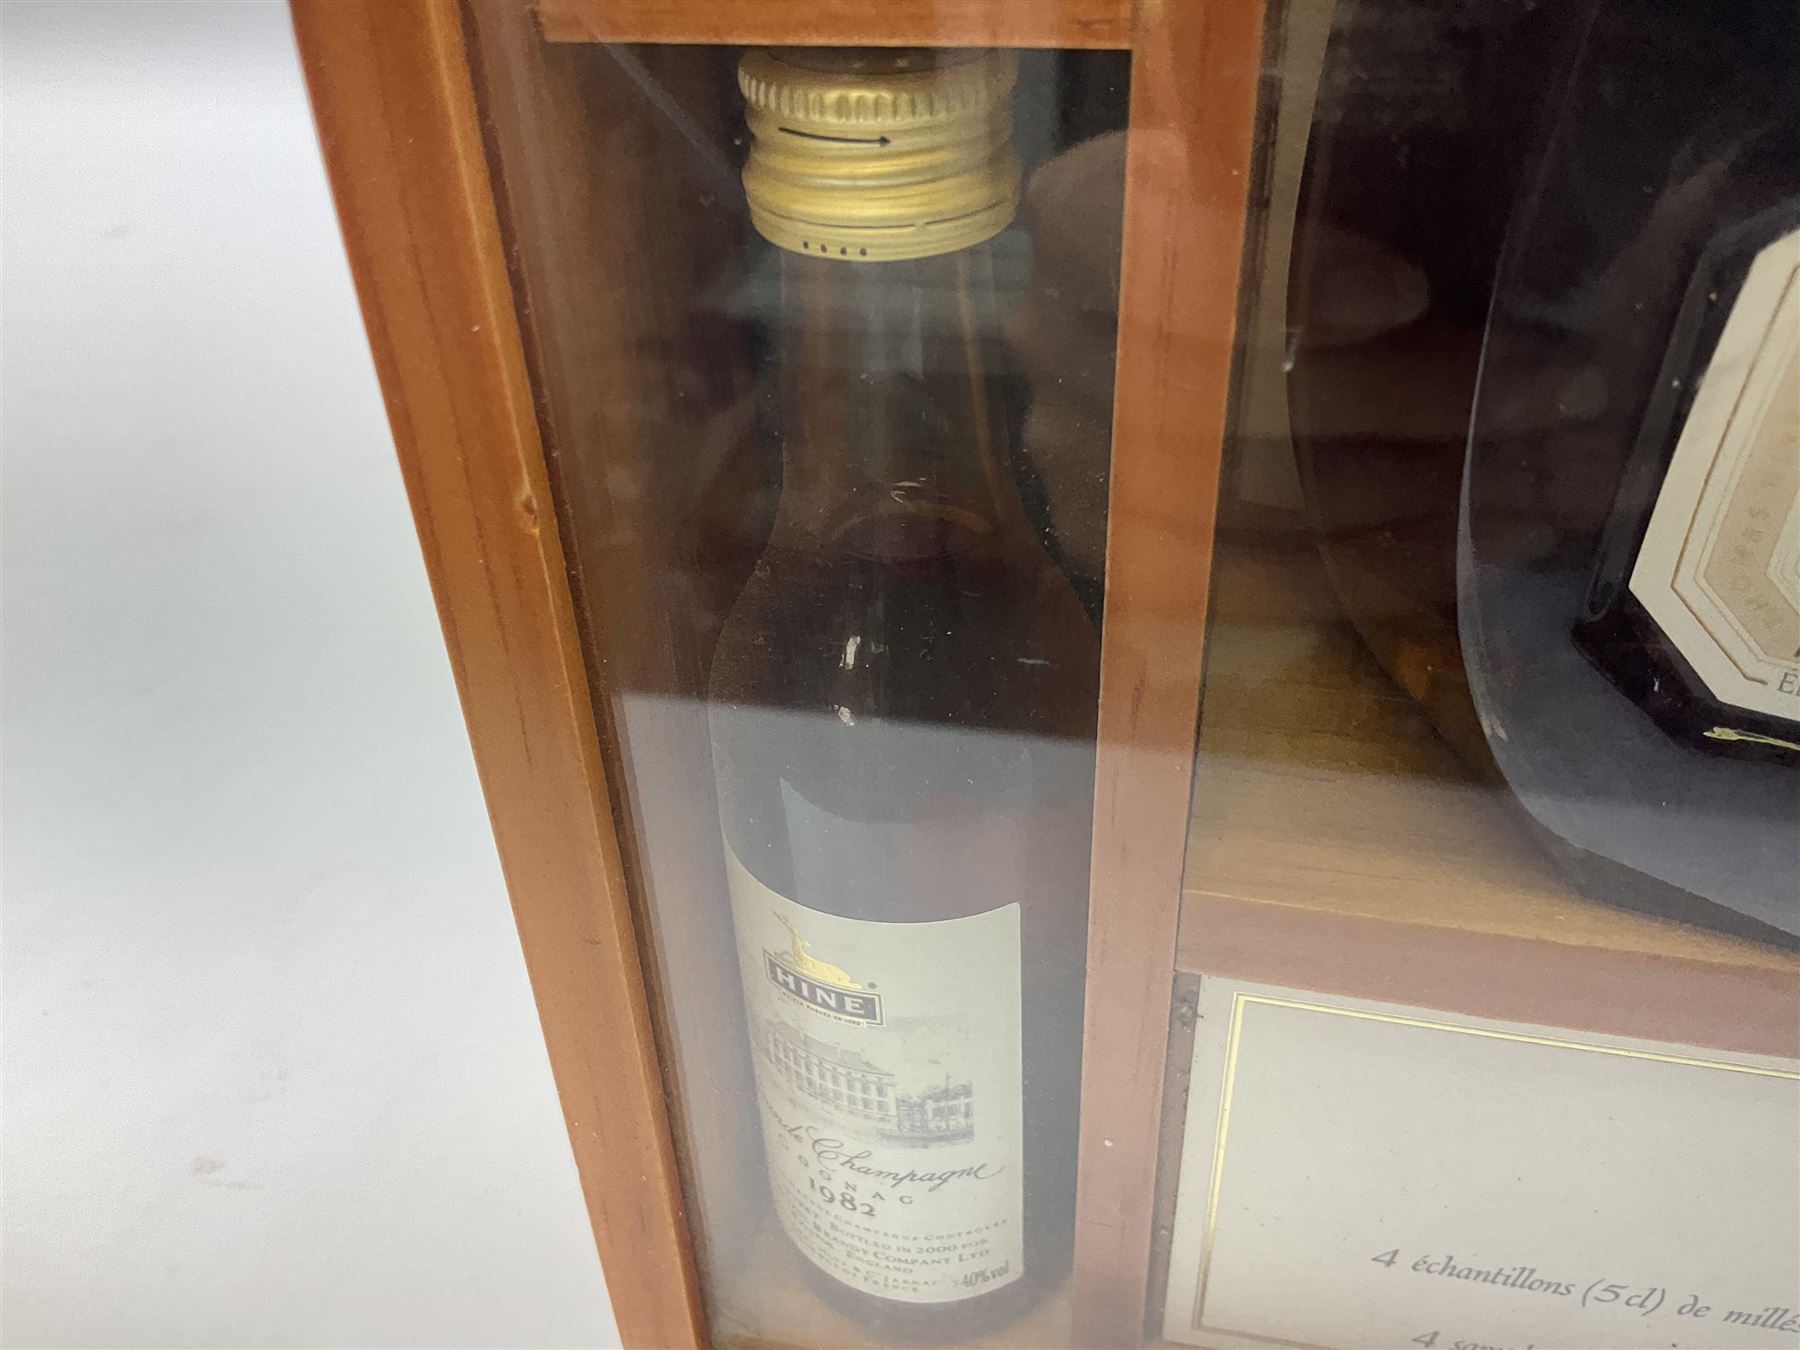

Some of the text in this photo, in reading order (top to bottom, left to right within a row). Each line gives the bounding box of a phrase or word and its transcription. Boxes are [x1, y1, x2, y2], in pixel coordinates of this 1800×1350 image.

[775, 966, 865, 1014] HINE
[805, 1125, 1005, 1192] Champagne
[808, 1175, 876, 1218] 1982
[829, 1221, 892, 1250] BOTTLED
[896, 1245, 912, 1254] IN
[916, 1244, 958, 1255] 2000
[872, 1247, 953, 1267] COMPANY
[957, 1248, 991, 1263] LTD
[845, 1249, 914, 1274] ENGLAND
[1370, 1248, 1400, 1268] 4
[1410, 1254, 1577, 1297] échantillons
[1677, 1294, 1712, 1318] de
[1411, 1329, 1440, 1349] 4
